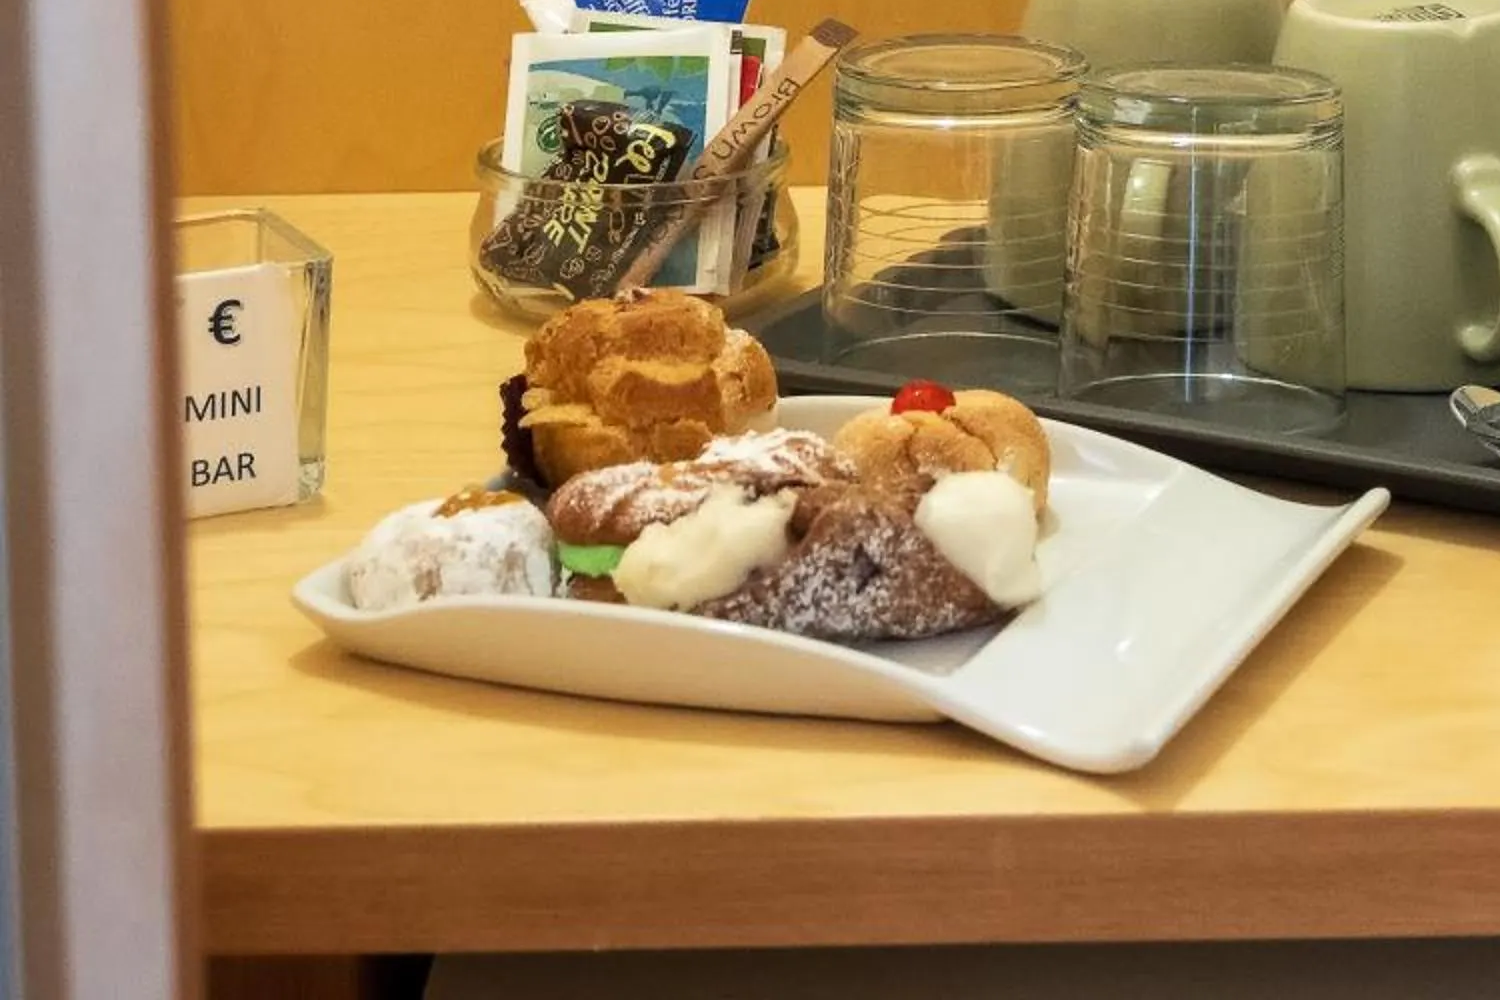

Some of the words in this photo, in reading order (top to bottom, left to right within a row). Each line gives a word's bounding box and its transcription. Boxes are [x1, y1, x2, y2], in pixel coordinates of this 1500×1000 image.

[207, 299, 243, 345] €
[184, 385, 262, 423] MINI
[191, 453, 257, 488] BAR
